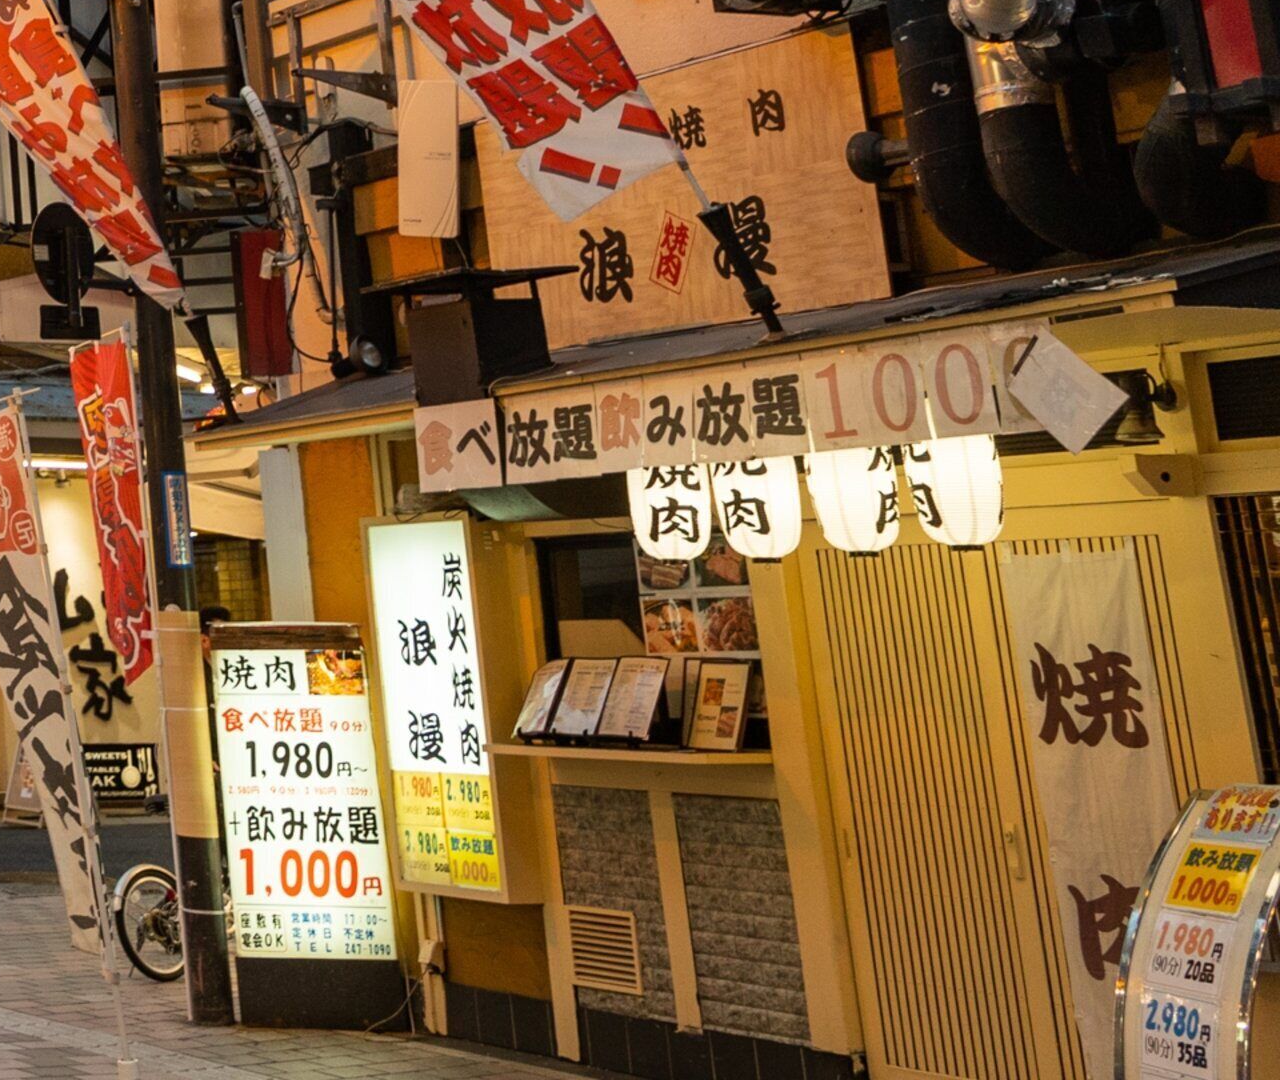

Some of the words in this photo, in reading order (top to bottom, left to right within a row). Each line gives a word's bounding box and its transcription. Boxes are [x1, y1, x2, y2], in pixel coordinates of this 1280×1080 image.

[669, 88, 786, 152] 焼肉
[656, 216, 690, 287] 焼肉
[419, 373, 805, 476] 食べ放題飲み放題
[441, 552, 482, 767] 炭火焼肉
[220, 655, 297, 691] 焼肉
[398, 618, 447, 765] 浪漫
[222, 707, 324, 733] 食べ放題
[84, 751, 128, 760] SWEETS
[91, 775, 116, 787] AK
[451, 836, 495, 856] 飲み放題
[1184, 847, 1257, 872] 飲み放題
[239, 847, 383, 899] 1,000円
[291, 913, 333, 924] 営業時間
[241, 932, 284, 948] 宴会OK
[292, 927, 332, 939] 定休日
[295, 942, 332, 953] TEL
[1184, 959, 1215, 984] 20品
[1177, 1041, 1208, 1069] 35品
